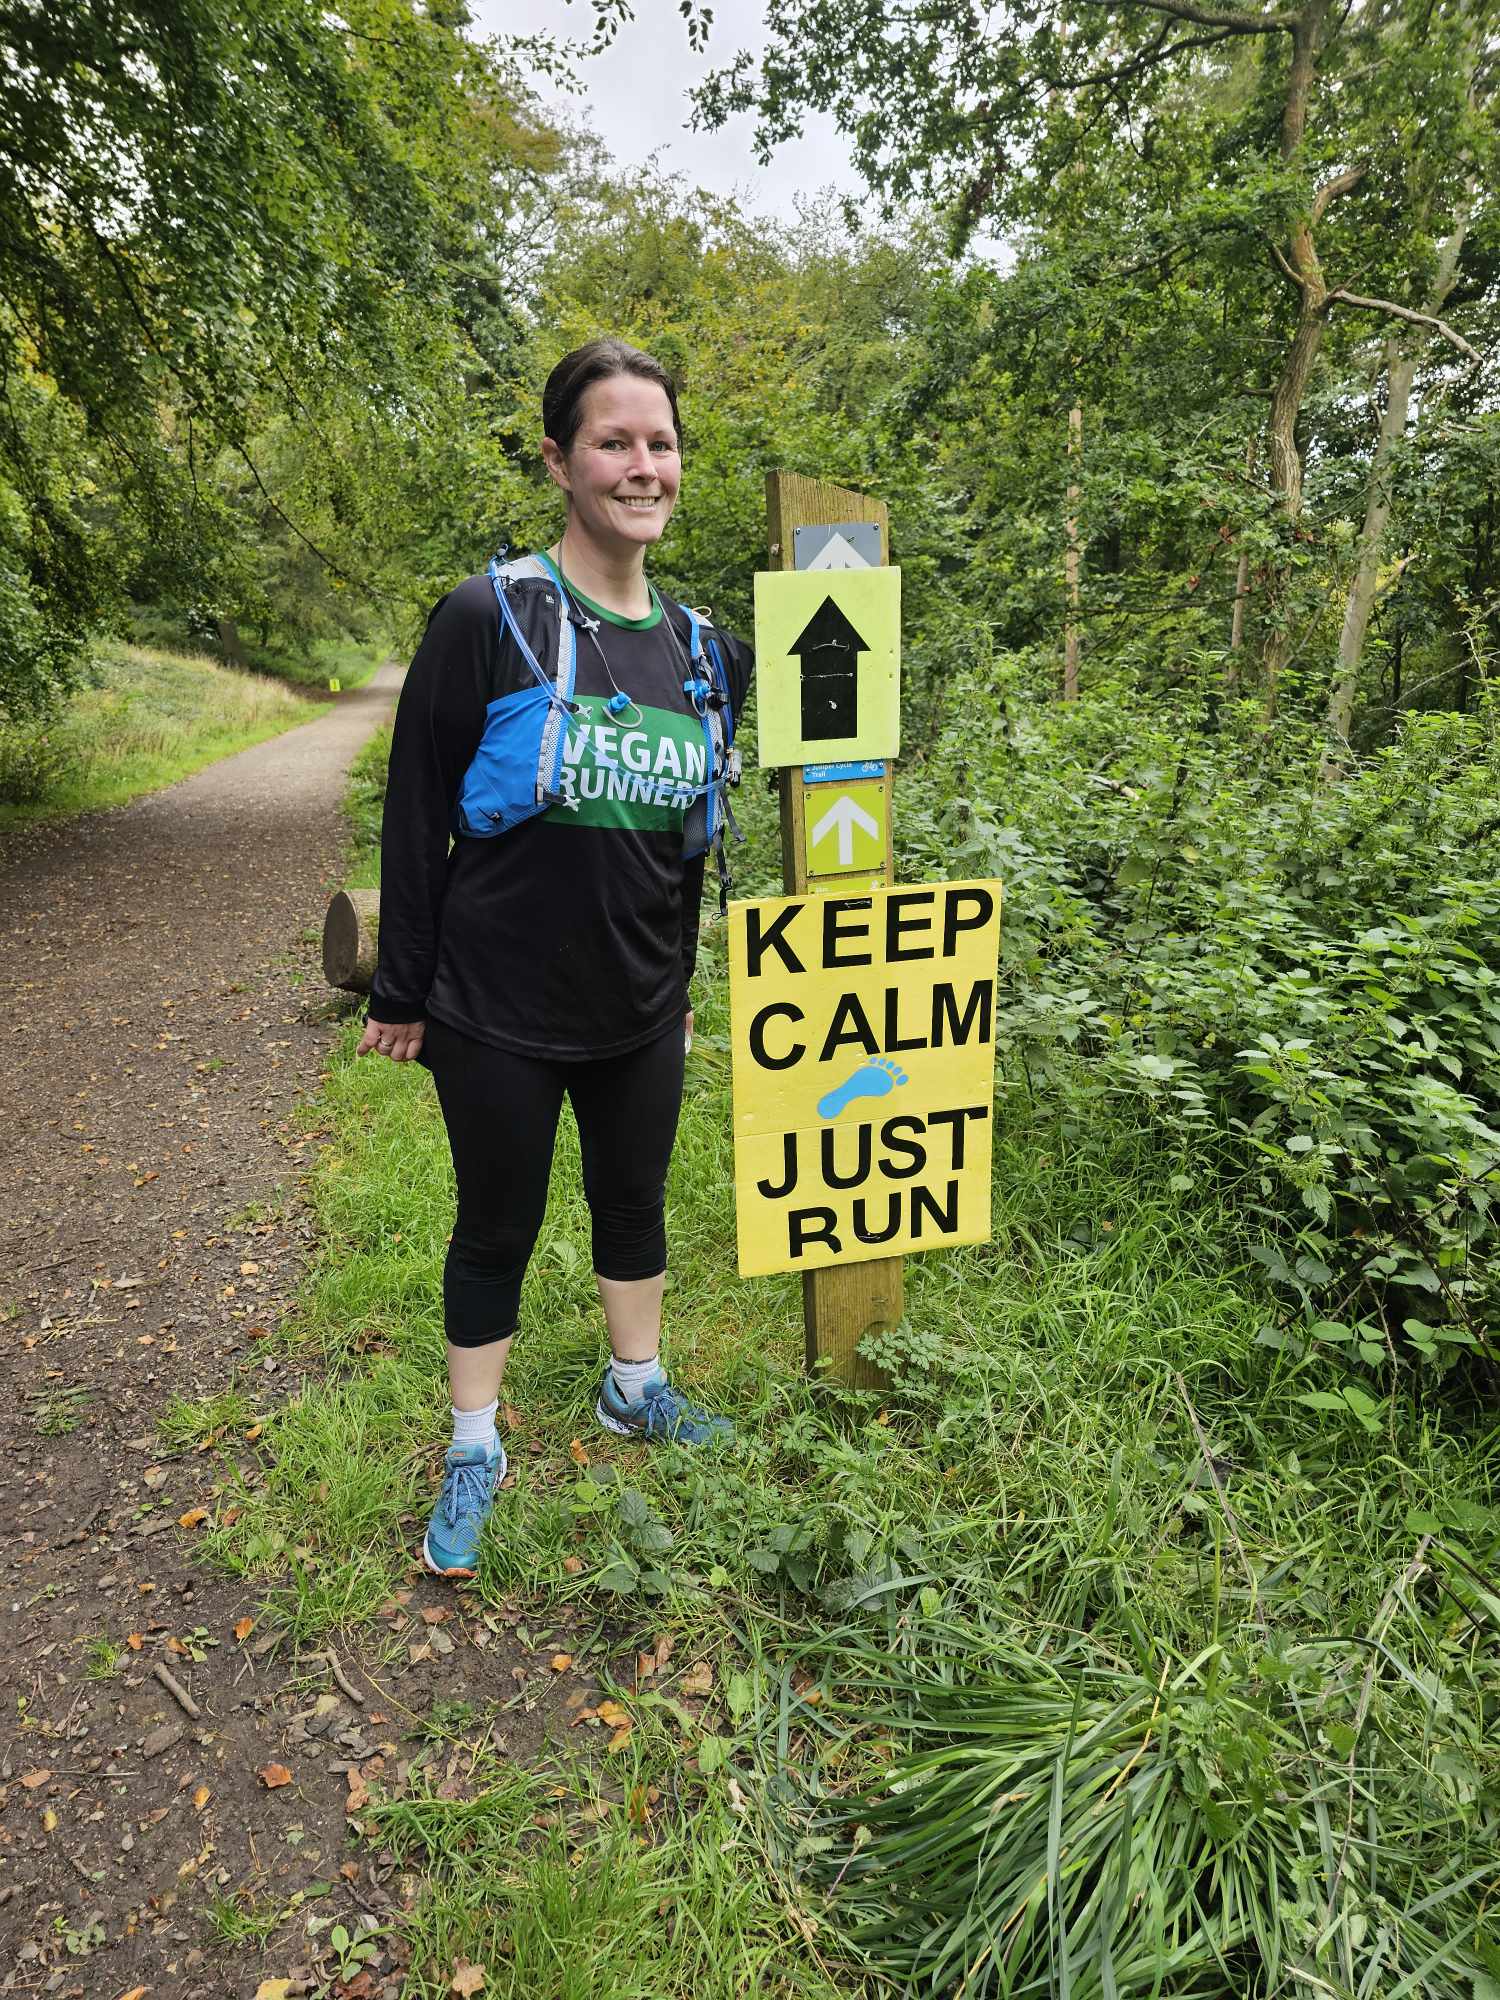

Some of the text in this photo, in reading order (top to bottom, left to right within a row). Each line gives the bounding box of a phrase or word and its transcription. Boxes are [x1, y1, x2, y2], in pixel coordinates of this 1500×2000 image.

[563, 724, 706, 783] VEGAN
[747, 889, 994, 977] KEEP
[750, 980, 993, 1070] CALM
[757, 1106, 989, 1199] JUST
[789, 1180, 958, 1259] RUN
